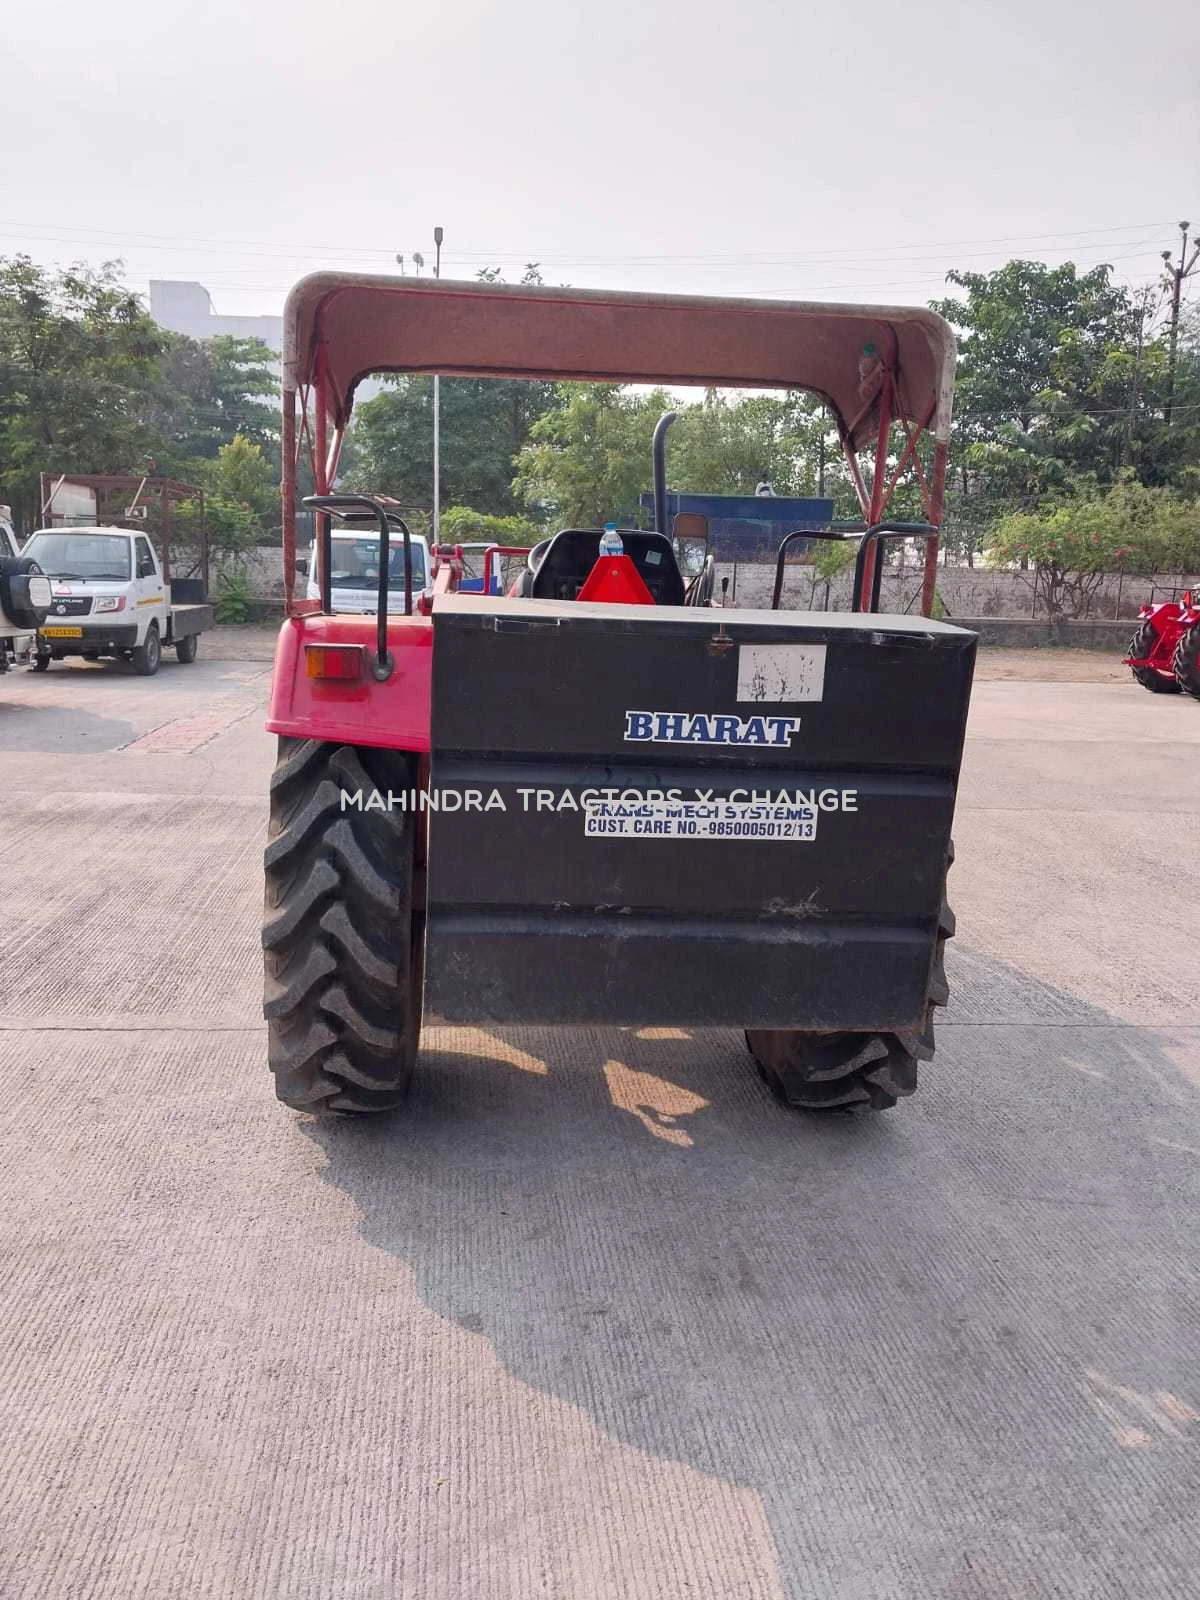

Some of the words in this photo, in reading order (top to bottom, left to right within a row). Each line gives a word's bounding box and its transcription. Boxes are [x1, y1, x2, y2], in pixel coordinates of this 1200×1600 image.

[624, 711, 800, 747] BHARAT
[725, 804, 815, 820] SYSTEMS
[587, 819, 628, 833] CUST.
[634, 819, 672, 834] CARE
